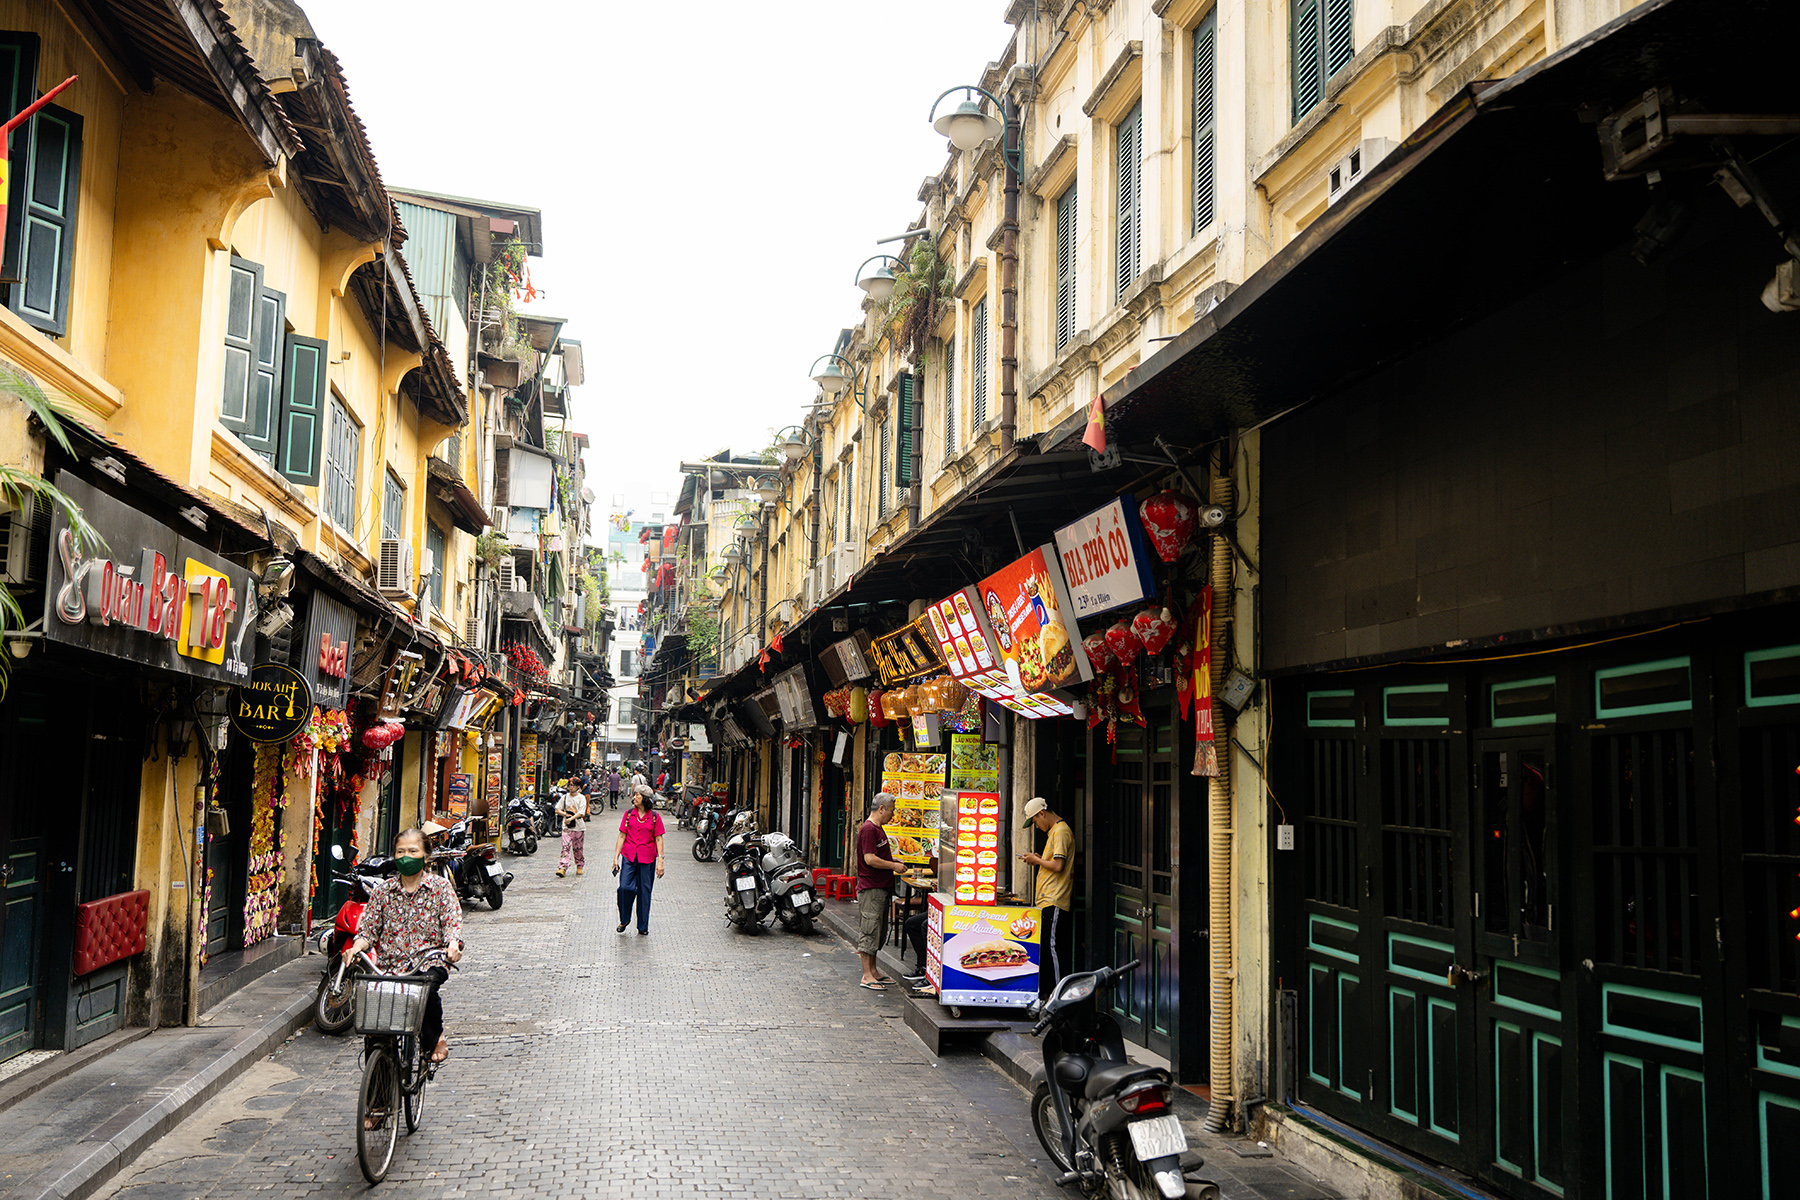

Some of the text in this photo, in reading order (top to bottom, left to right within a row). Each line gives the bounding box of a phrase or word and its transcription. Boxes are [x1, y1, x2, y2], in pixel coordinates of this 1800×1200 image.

[1063, 547, 1088, 589] BIA
[1082, 517, 1110, 581] PHỐ
[143, 549, 188, 642] Bar
[238, 702, 281, 721] BAR
[949, 906, 1009, 922] Bami Bread
[952, 920, 971, 931] Old
